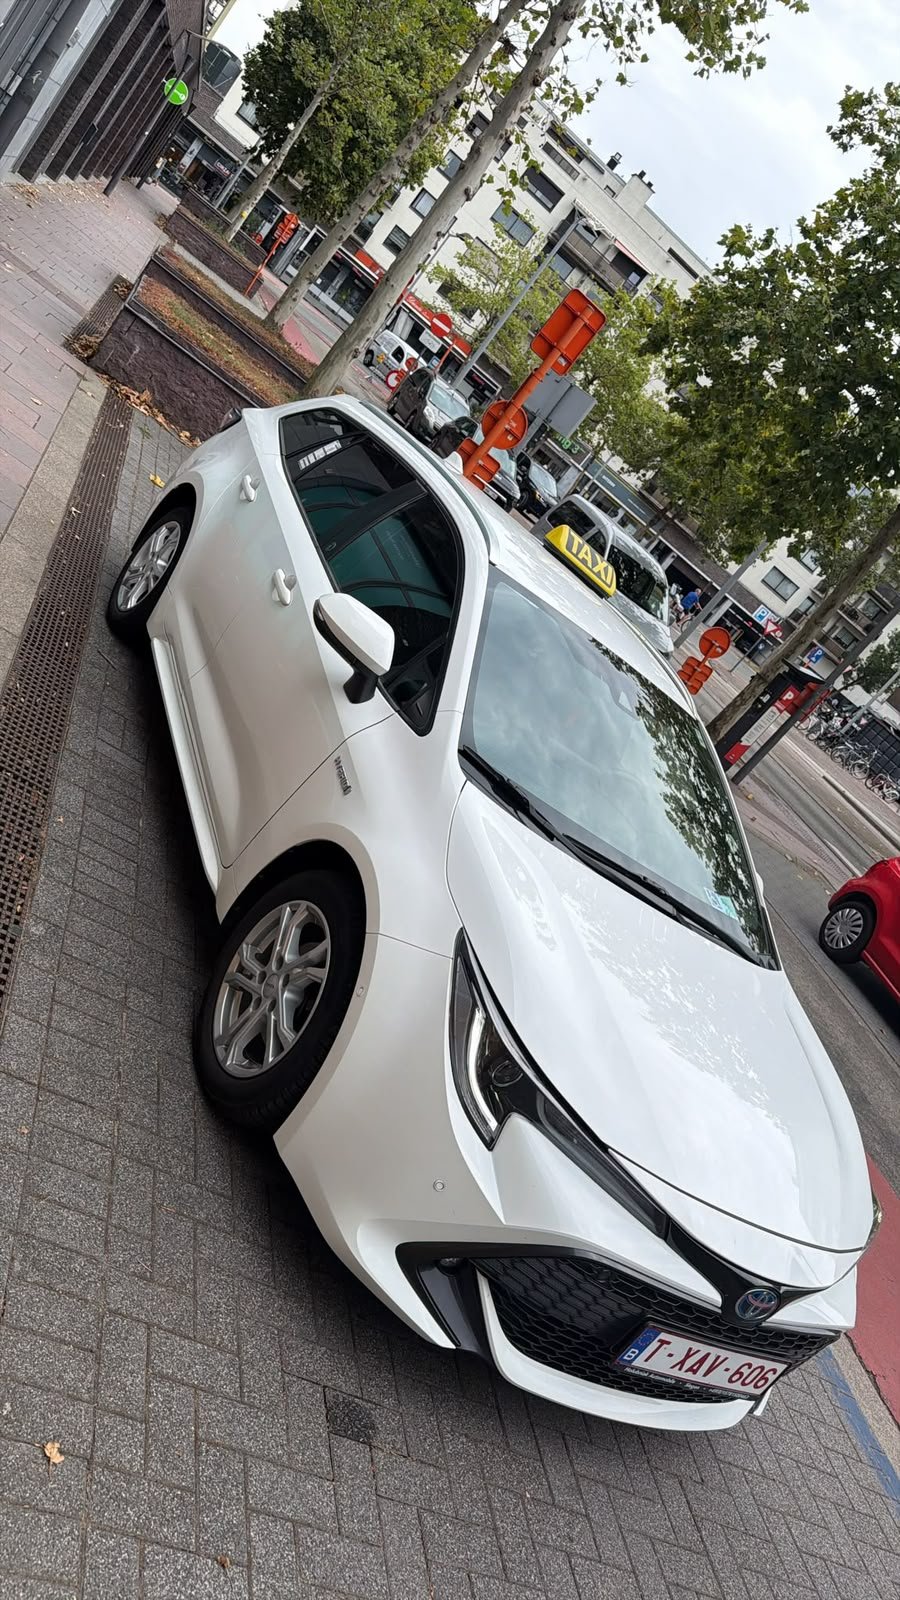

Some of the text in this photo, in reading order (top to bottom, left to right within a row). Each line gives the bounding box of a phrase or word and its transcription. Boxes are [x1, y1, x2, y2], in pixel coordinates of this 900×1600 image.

[570, 531, 613, 585] TAXI
[813, 649, 823, 658] P
[783, 690, 794, 702] P
[624, 1348, 640, 1361] B
[643, 1337, 778, 1389] T-XAV-606
